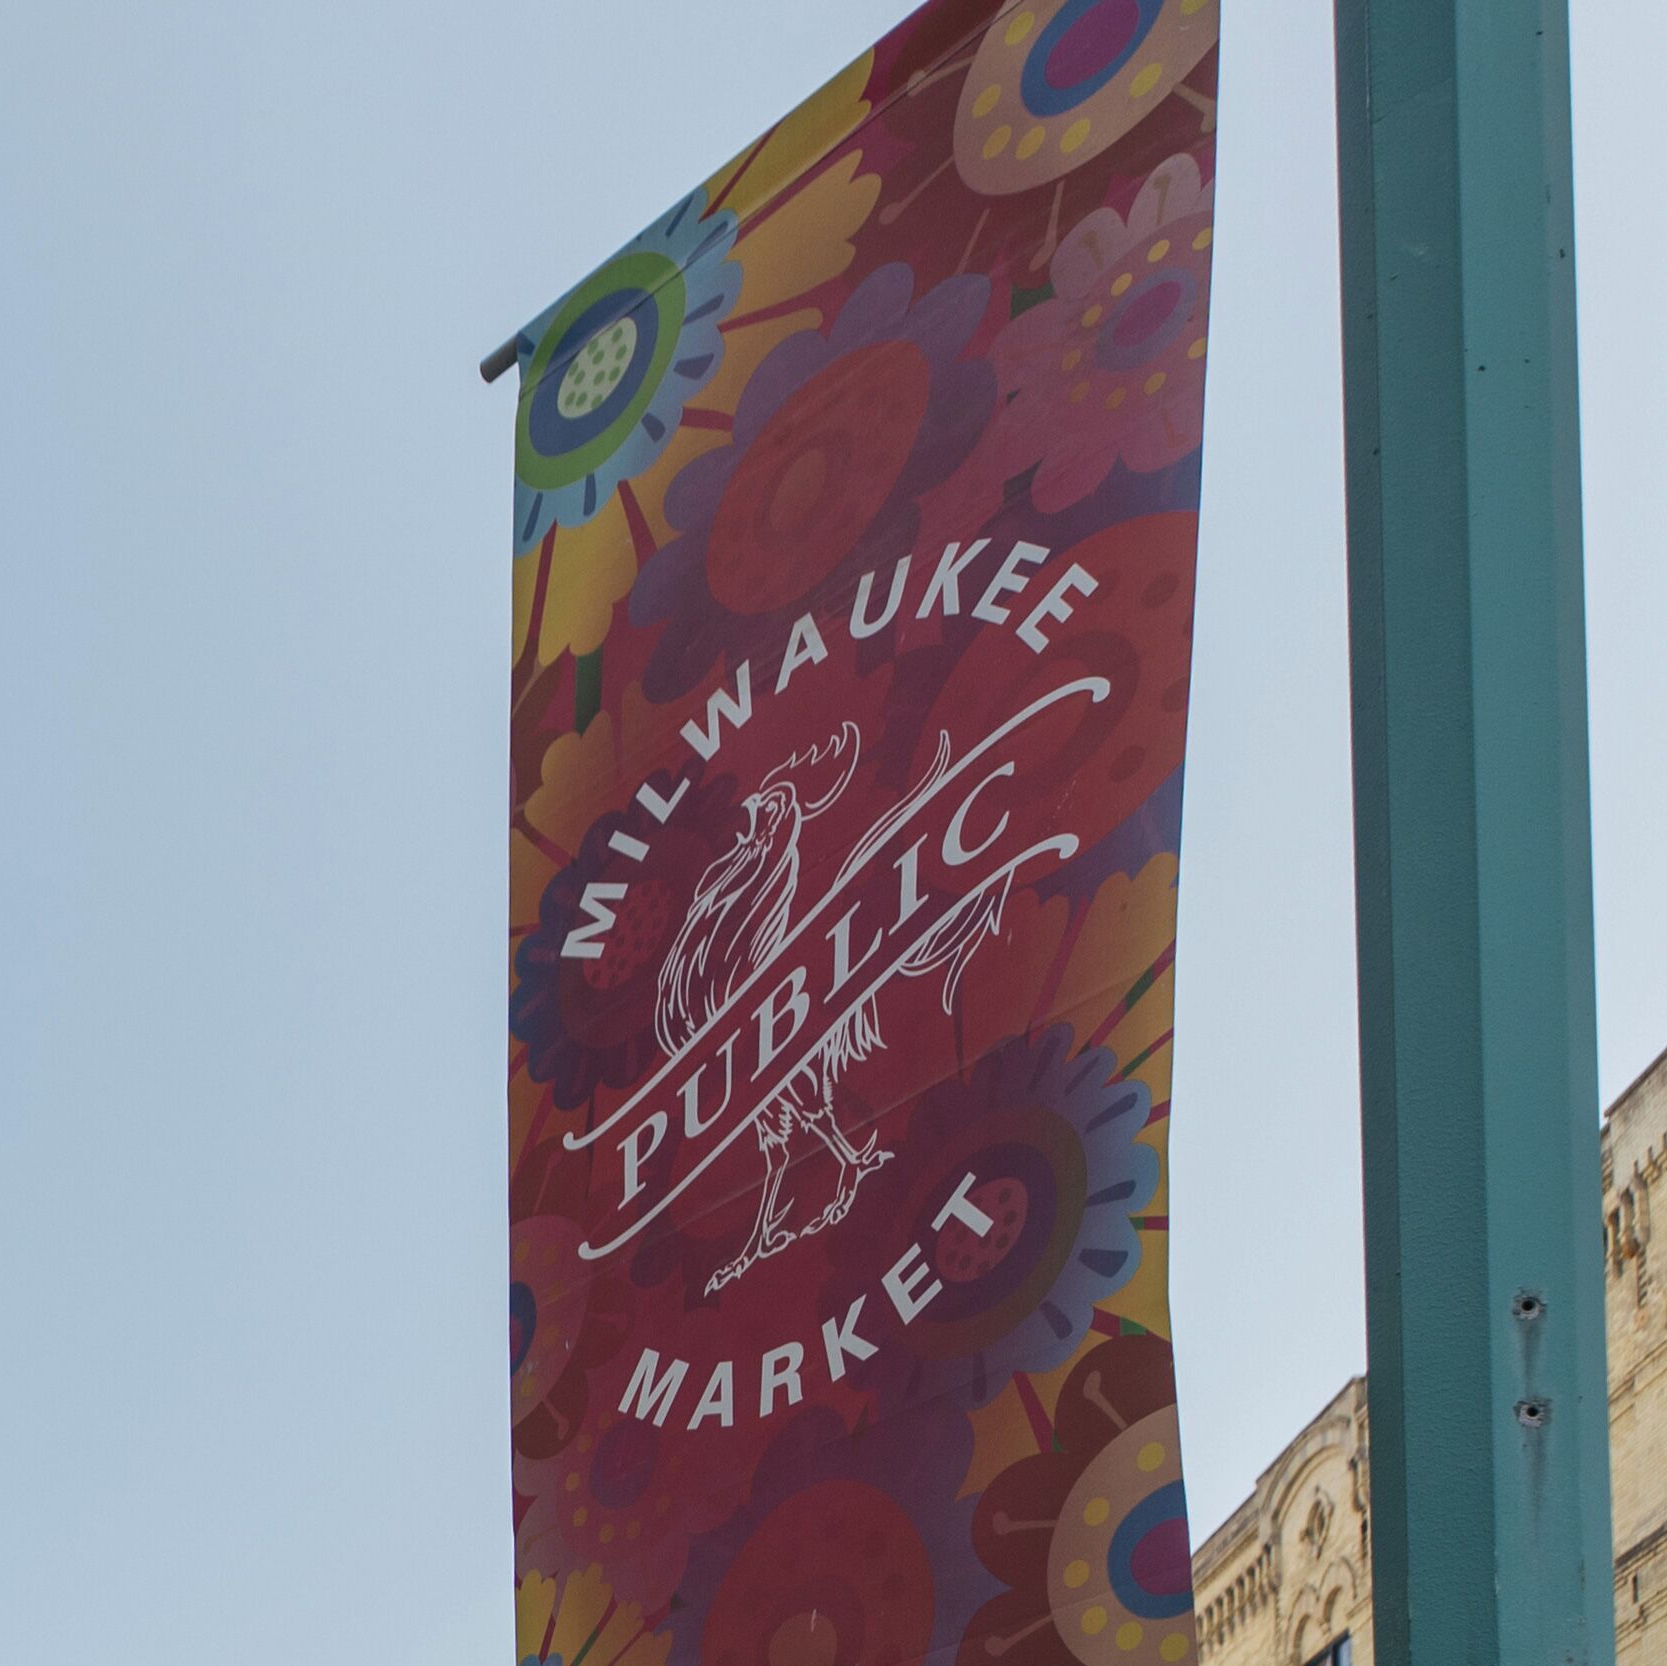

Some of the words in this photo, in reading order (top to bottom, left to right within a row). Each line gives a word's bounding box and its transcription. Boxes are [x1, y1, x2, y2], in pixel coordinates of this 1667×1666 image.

[560, 537, 1099, 960] MILWAUKEE
[615, 762, 1017, 1212] PUBLIC
[617, 1172, 1000, 1432] MARKET
